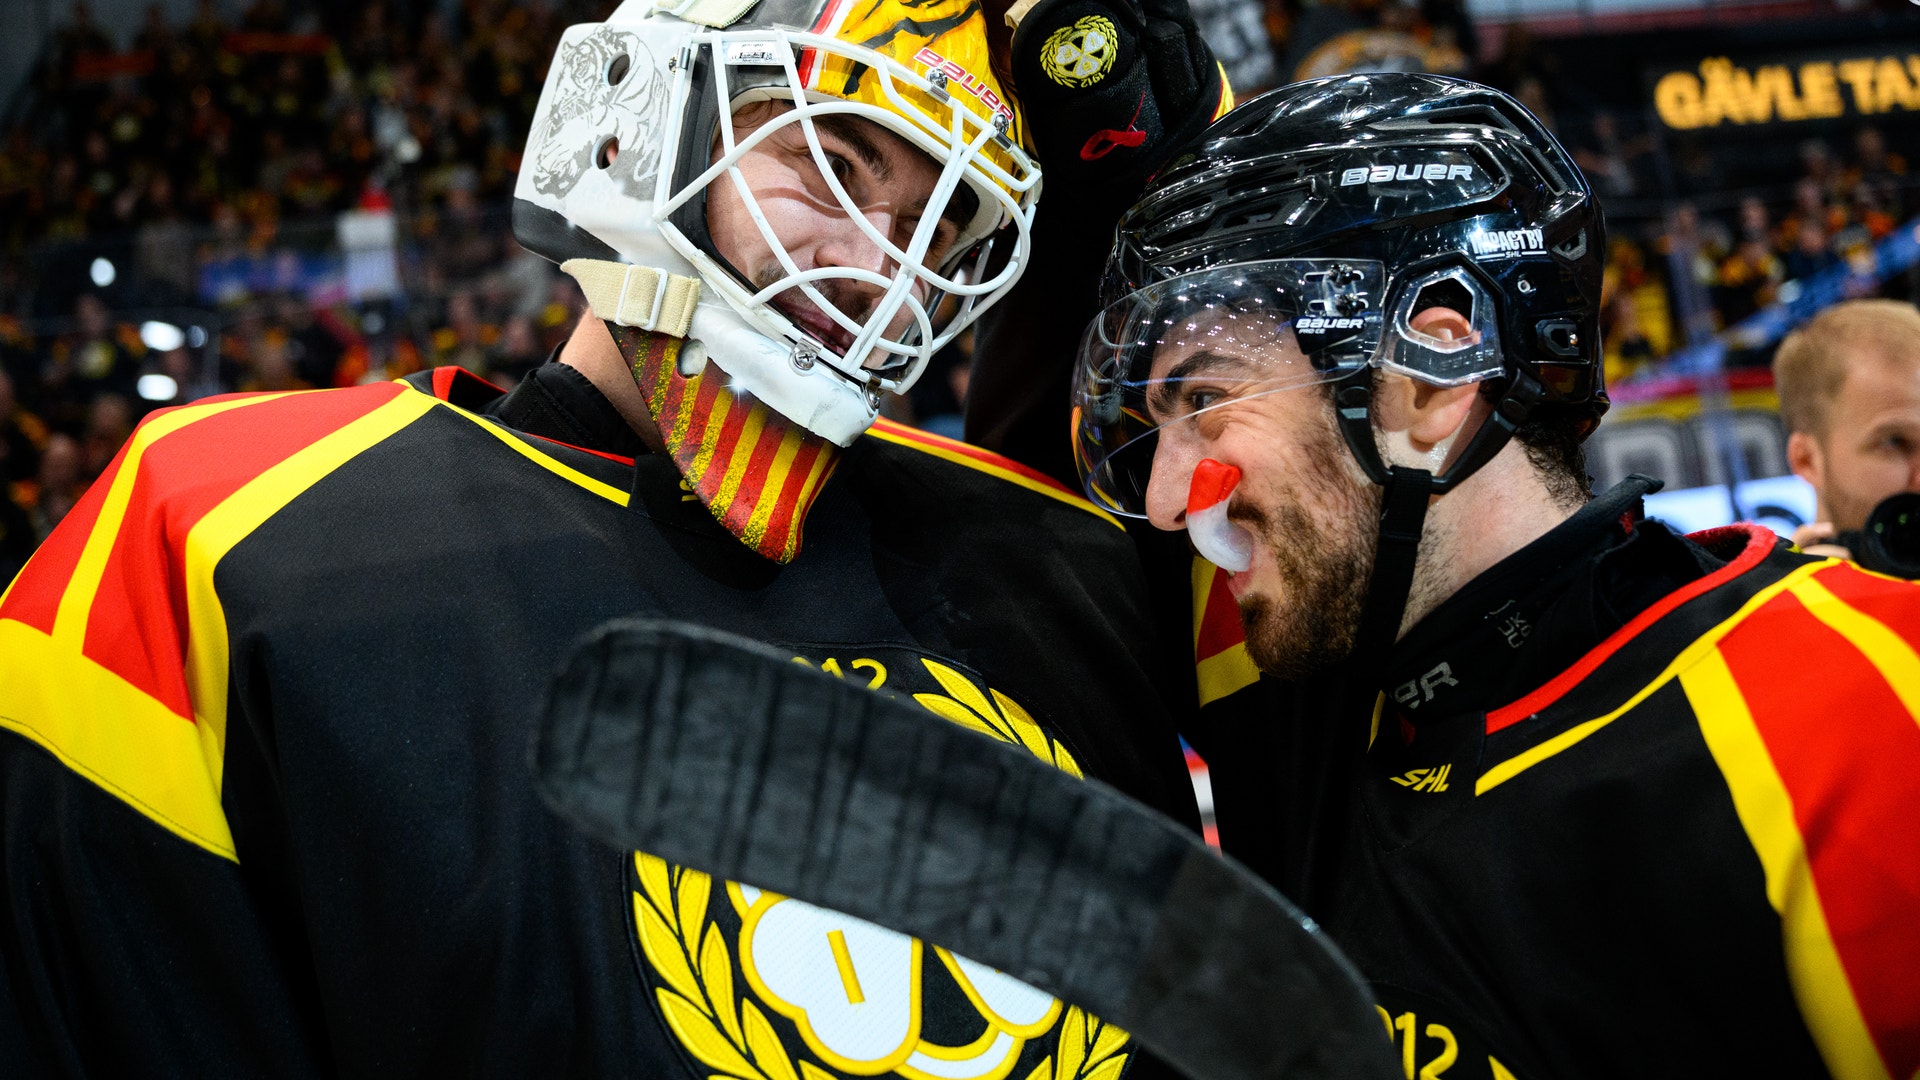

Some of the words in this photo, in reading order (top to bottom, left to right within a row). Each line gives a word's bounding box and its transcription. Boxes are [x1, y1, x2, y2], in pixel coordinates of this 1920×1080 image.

[1080, 71, 1106, 88] 1912
[1655, 56, 1844, 129] GÄVLE
[1340, 163, 1473, 187] BAUER
[1469, 230, 1526, 254] IMPACT
[1528, 229, 1544, 249] BY
[1295, 318, 1364, 329] BAUER
[1388, 762, 1452, 793] SHL
[1373, 1003, 1459, 1080] 12
